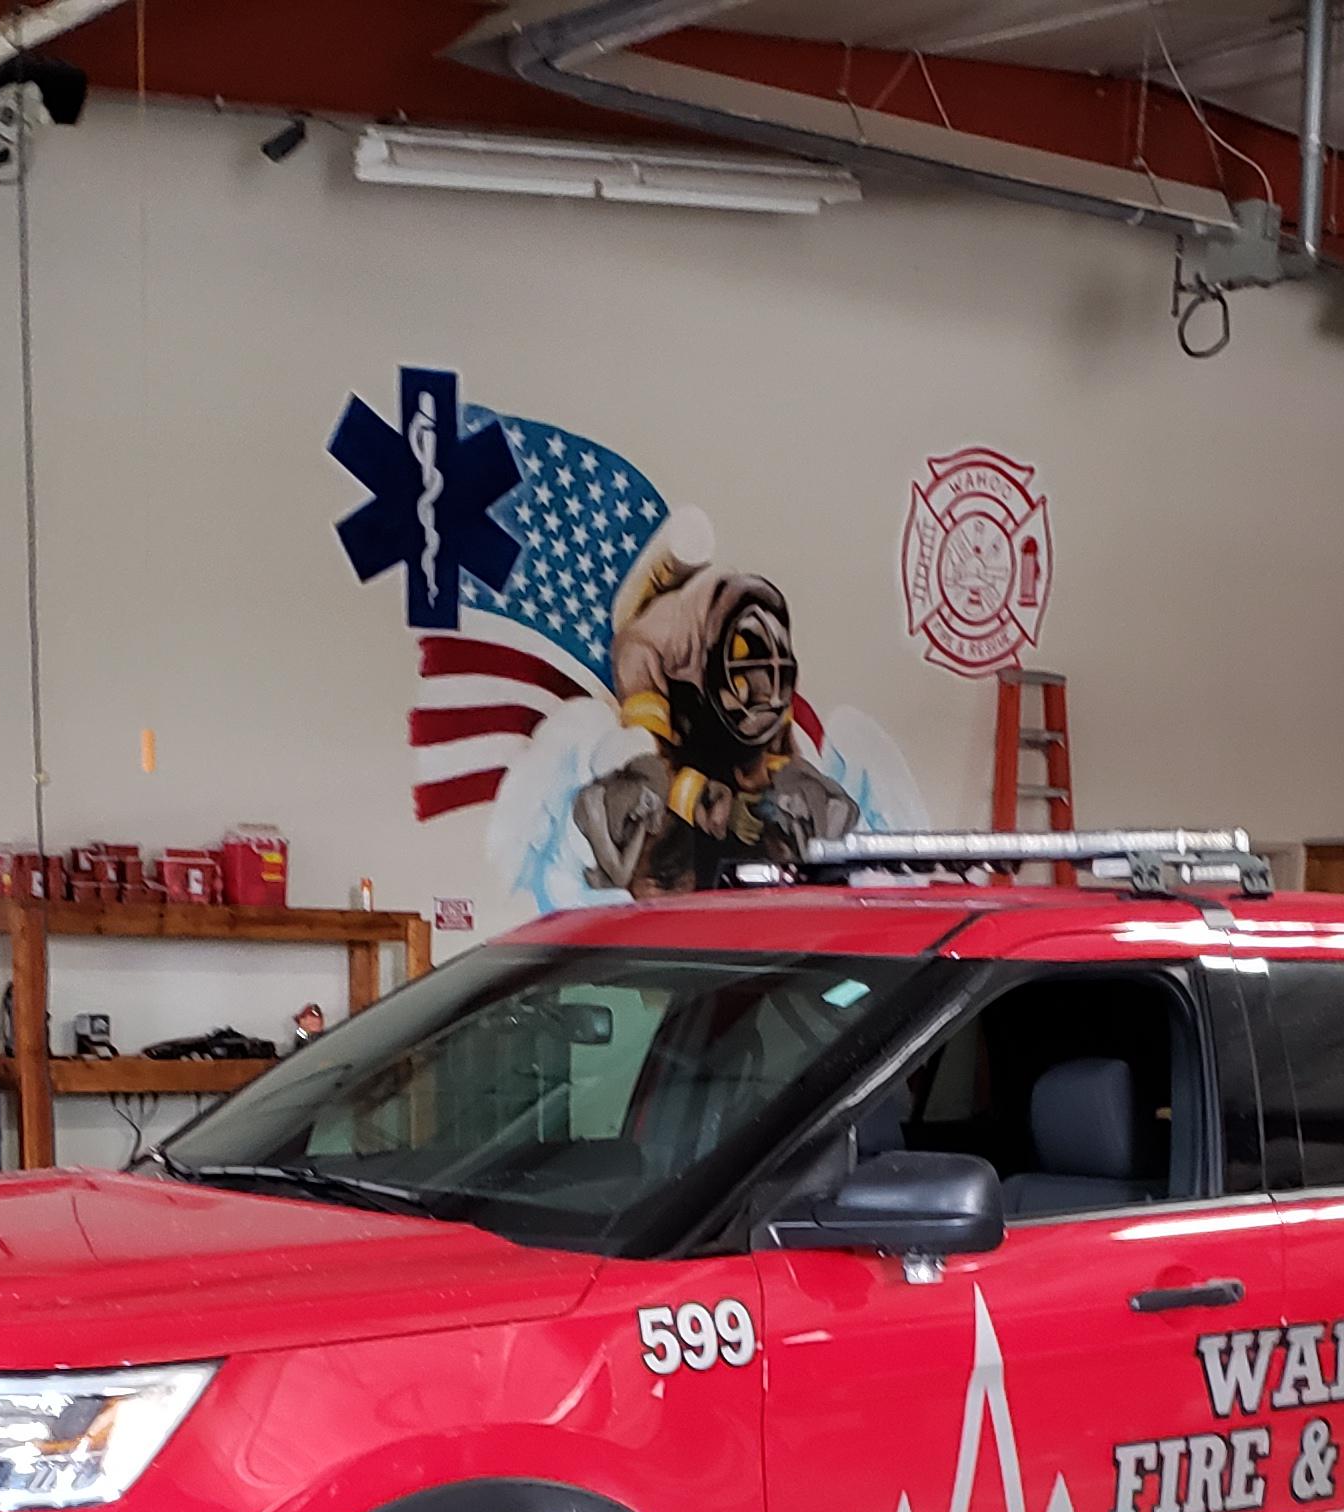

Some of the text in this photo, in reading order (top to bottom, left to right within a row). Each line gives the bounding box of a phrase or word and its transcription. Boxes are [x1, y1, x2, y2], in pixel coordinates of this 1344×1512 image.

[946, 468, 1013, 500] WAHOO
[637, 1298, 757, 1376] 599
[1291, 1417, 1340, 1502] &
